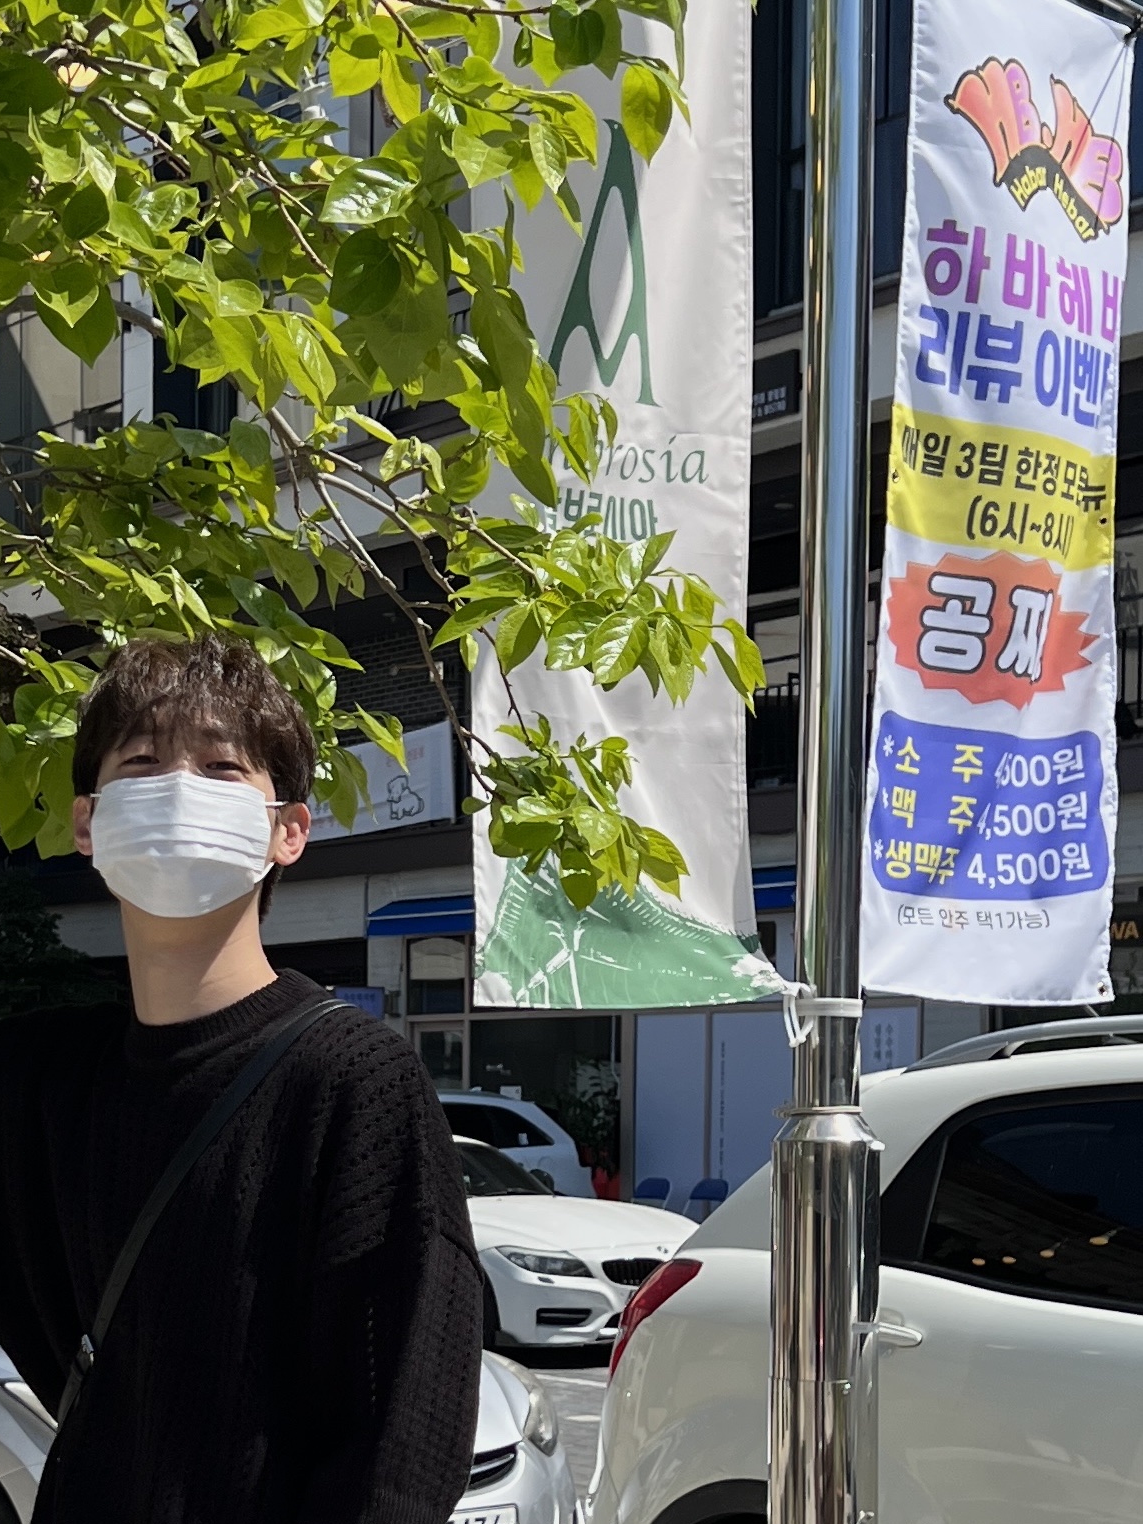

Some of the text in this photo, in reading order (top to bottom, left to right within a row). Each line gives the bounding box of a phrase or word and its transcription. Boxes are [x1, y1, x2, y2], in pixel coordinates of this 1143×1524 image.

[1009, 165, 1096, 239] Habar Hebar
[915, 303, 1113, 429] 리뷰 이벤
[902, 425, 951, 478] 매일
[955, 441, 1009, 487] 3팀
[1014, 446, 1061, 497] 한정
[967, 842, 1094, 890] 4,500원
[897, 903, 934, 926] (모든
[939, 907, 970, 930] 안주
